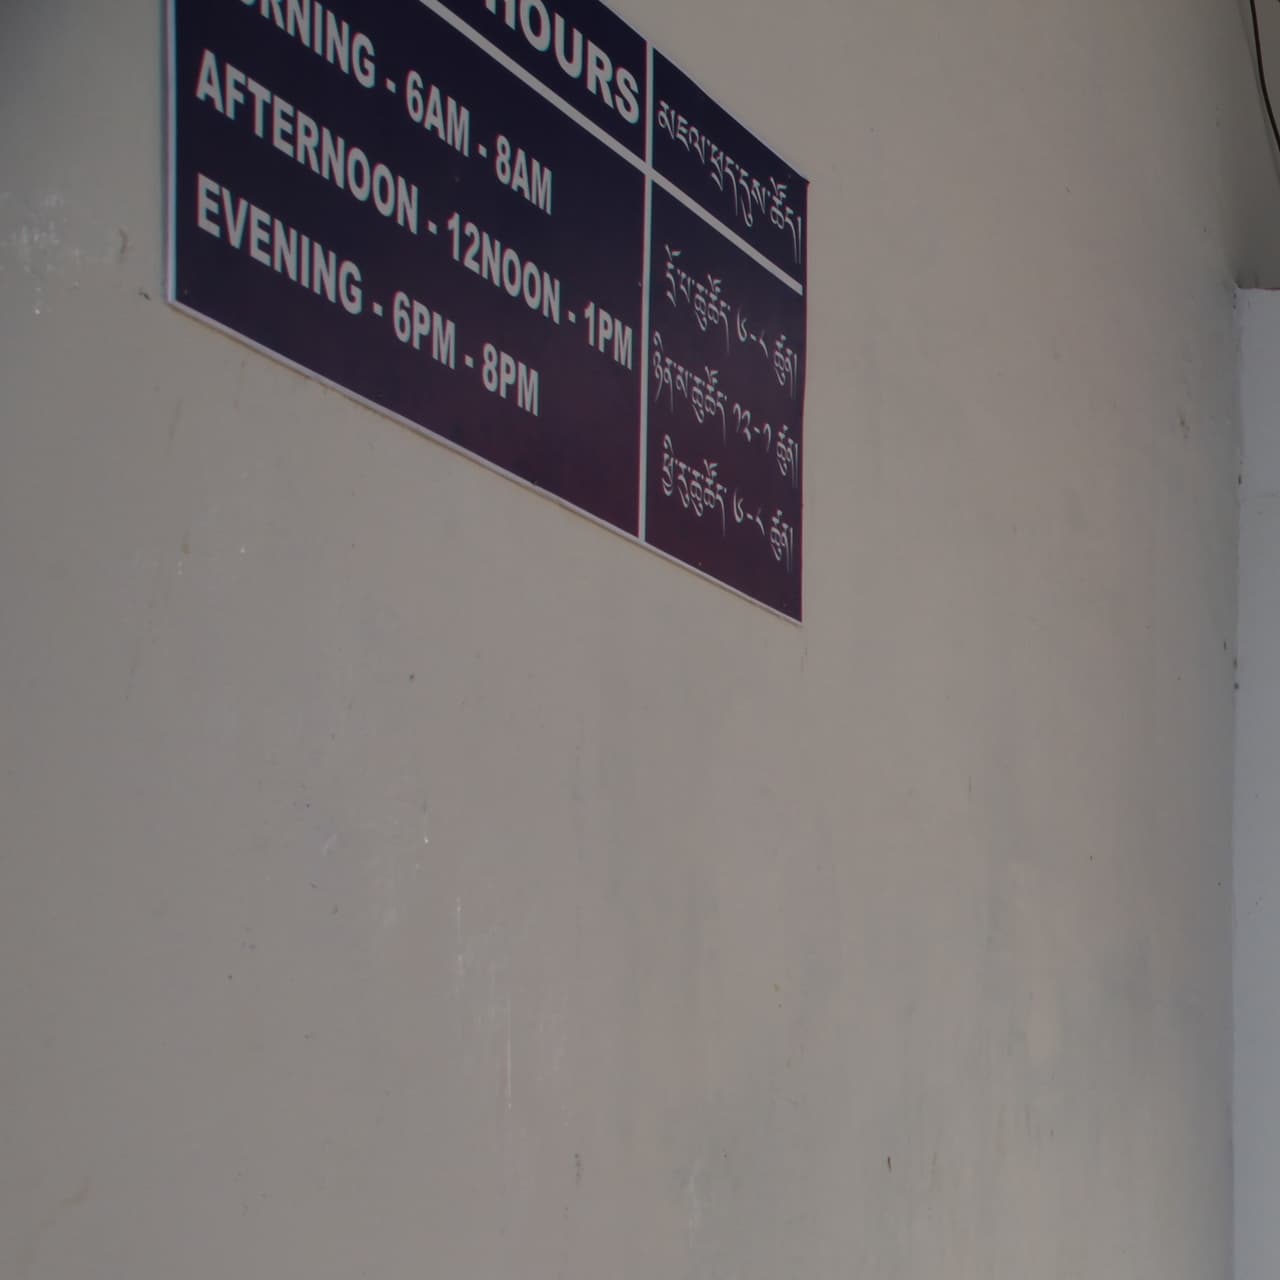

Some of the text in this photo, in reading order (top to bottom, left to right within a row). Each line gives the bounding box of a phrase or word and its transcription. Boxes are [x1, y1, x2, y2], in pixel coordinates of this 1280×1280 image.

[196, 49, 633, 371] AFTERNOON - 12NOON - 1PM
[386, 78, 396, 93] -
[406, 70, 470, 157] 6AM
[478, 143, 487, 158] -
[495, 135, 552, 215] 8AM
[197, 173, 540, 417] EVENING - 6PM - 8PM
